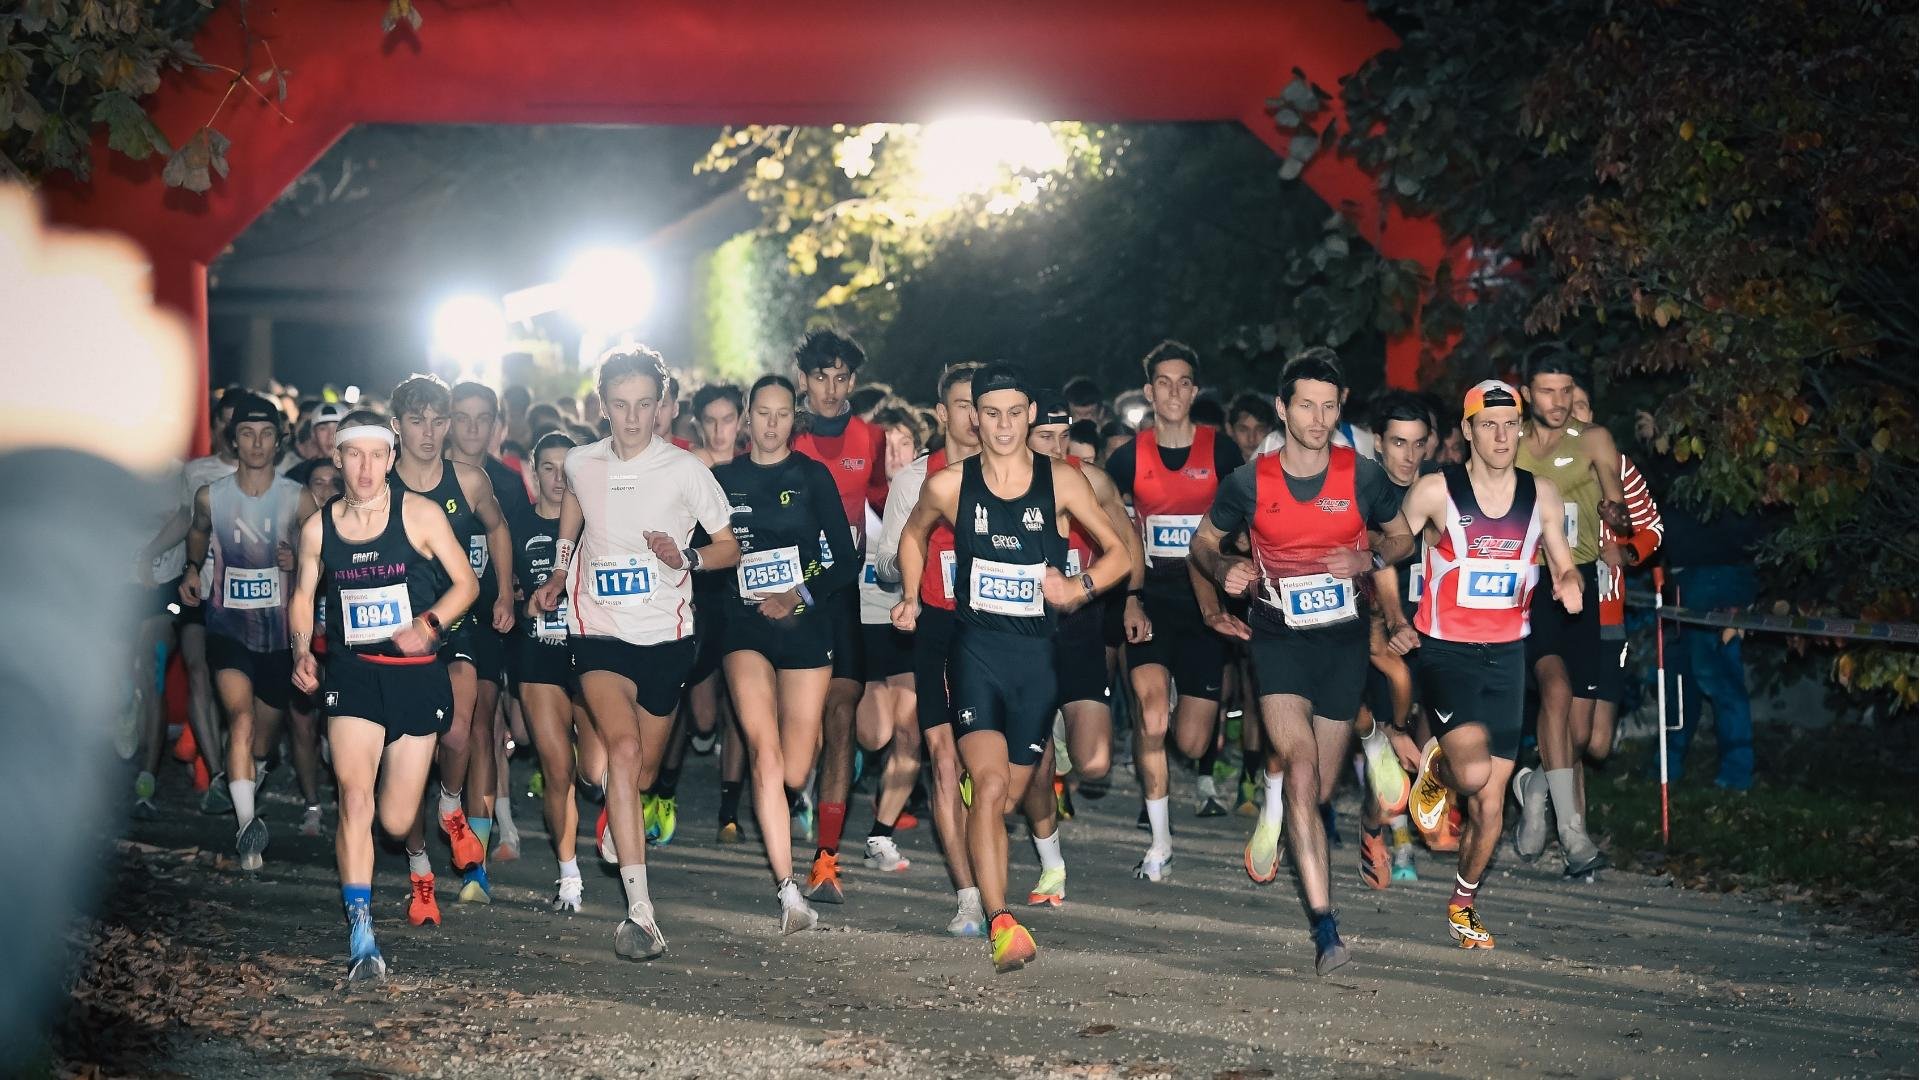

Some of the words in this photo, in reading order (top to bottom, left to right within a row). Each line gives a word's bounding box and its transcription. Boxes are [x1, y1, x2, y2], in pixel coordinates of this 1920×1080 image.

[1159, 529, 1191, 545] 440
[598, 570, 646, 592] 1171
[745, 563, 792, 587] 2553
[1474, 575, 1511, 594] 441
[231, 581, 271, 598] 1158
[980, 576, 1034, 600] 2558
[1299, 589, 1338, 611] 835
[356, 603, 395, 627] 894
